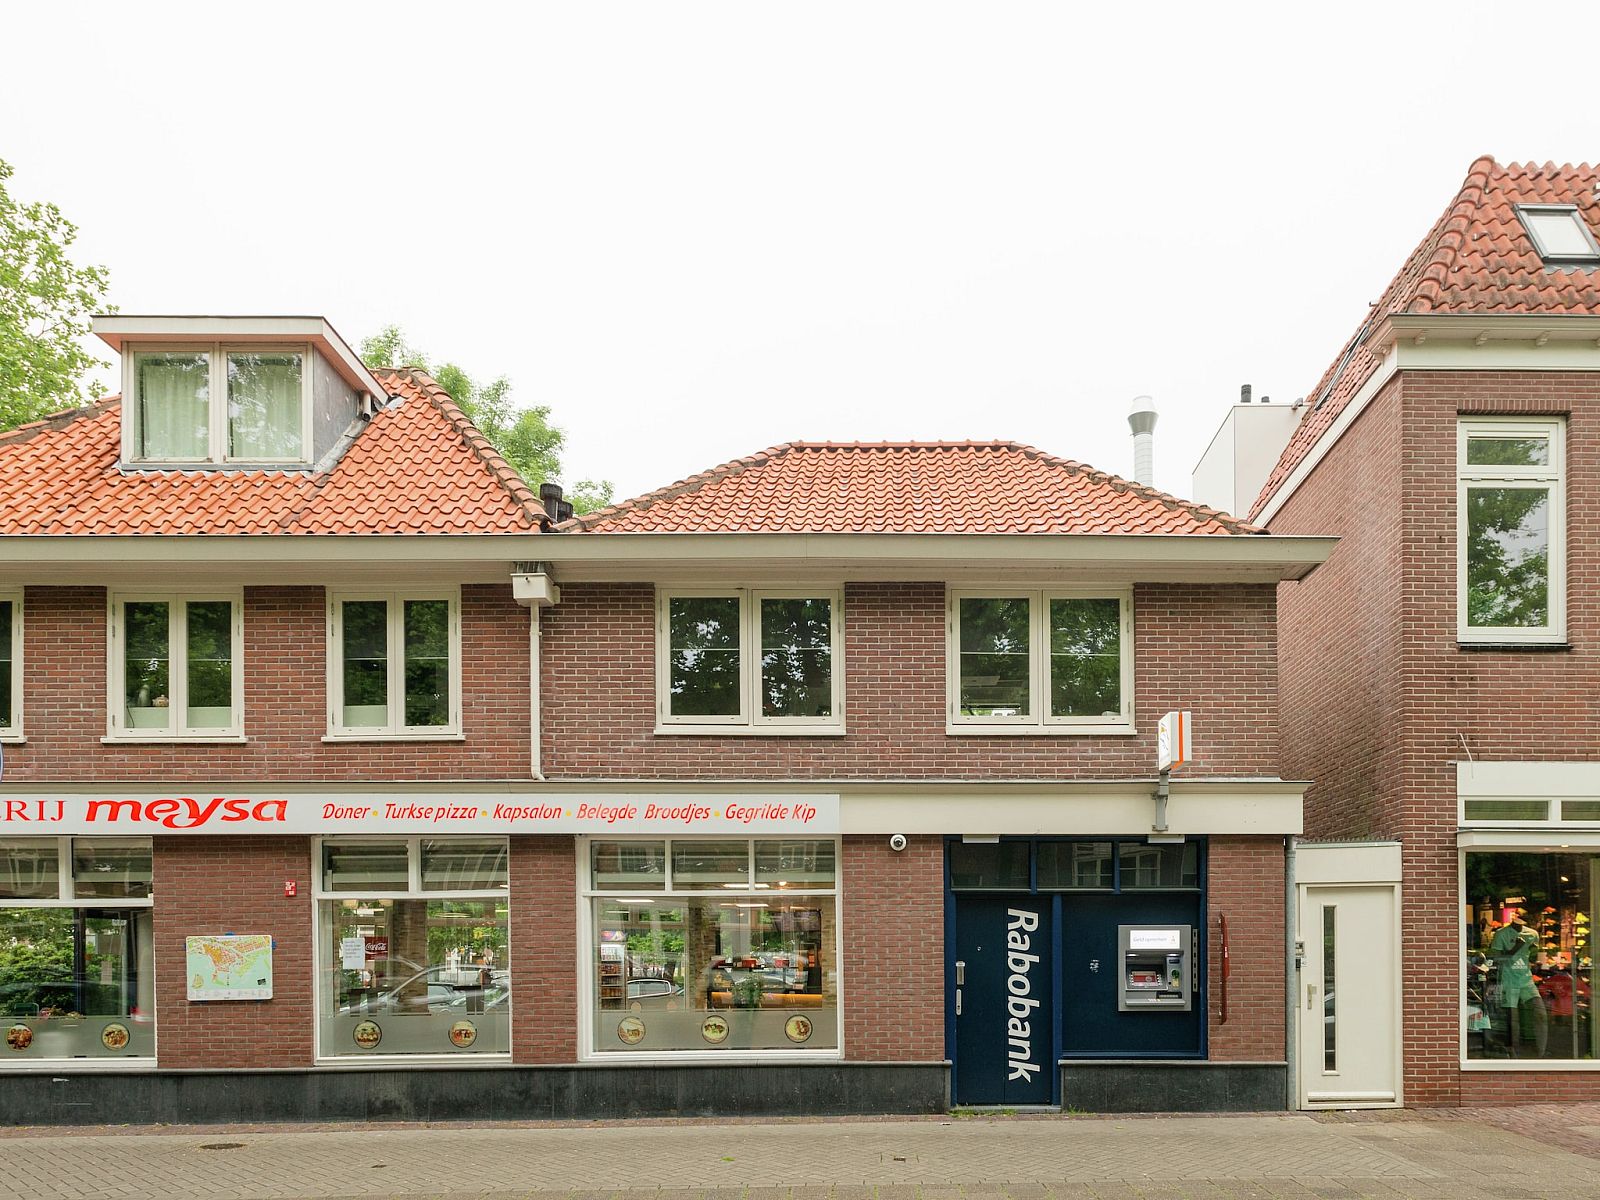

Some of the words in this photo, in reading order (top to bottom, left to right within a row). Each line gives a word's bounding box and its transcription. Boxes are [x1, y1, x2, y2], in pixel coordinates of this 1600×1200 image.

[0, 800, 66, 822] RIJ
[85, 798, 288, 829] meysa
[434, 803, 478, 823] pizza
[493, 804, 562, 823] Kapsalon
[576, 804, 637, 823] Belegde
[644, 804, 711, 824] Broodjes
[725, 804, 789, 824] Gegrilde
[792, 804, 816, 823] Kip
[1007, 908, 1041, 1083] Rabobank
